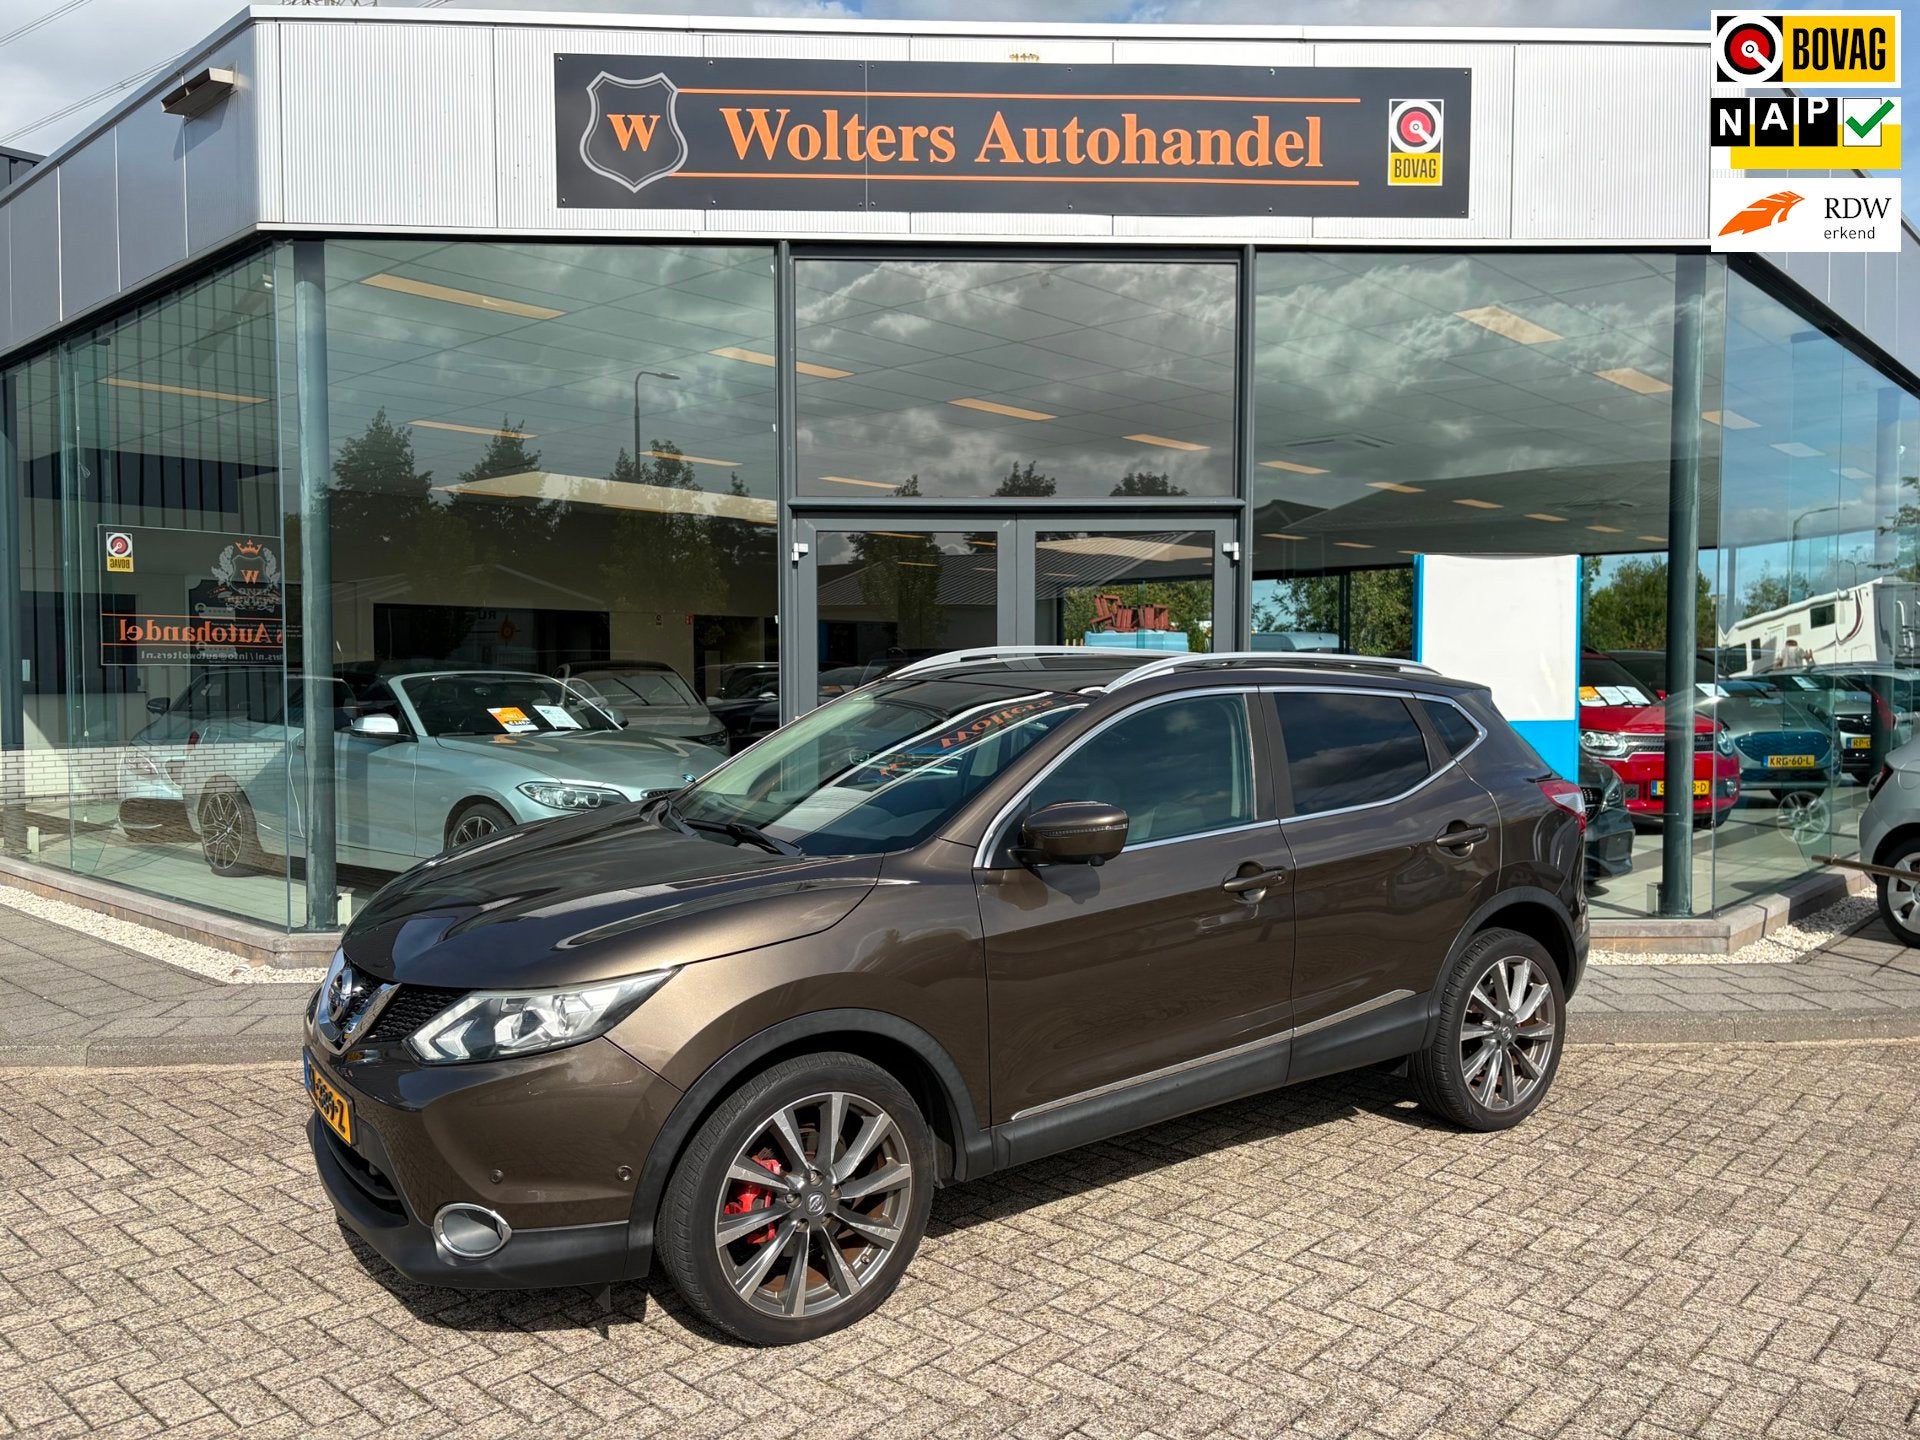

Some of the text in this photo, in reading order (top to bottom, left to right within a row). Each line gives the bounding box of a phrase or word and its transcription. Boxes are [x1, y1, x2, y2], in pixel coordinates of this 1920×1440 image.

[607, 113, 661, 151] W
[720, 107, 1324, 168] Wolters Autohandel
[1392, 159, 1438, 179] BOVAG
